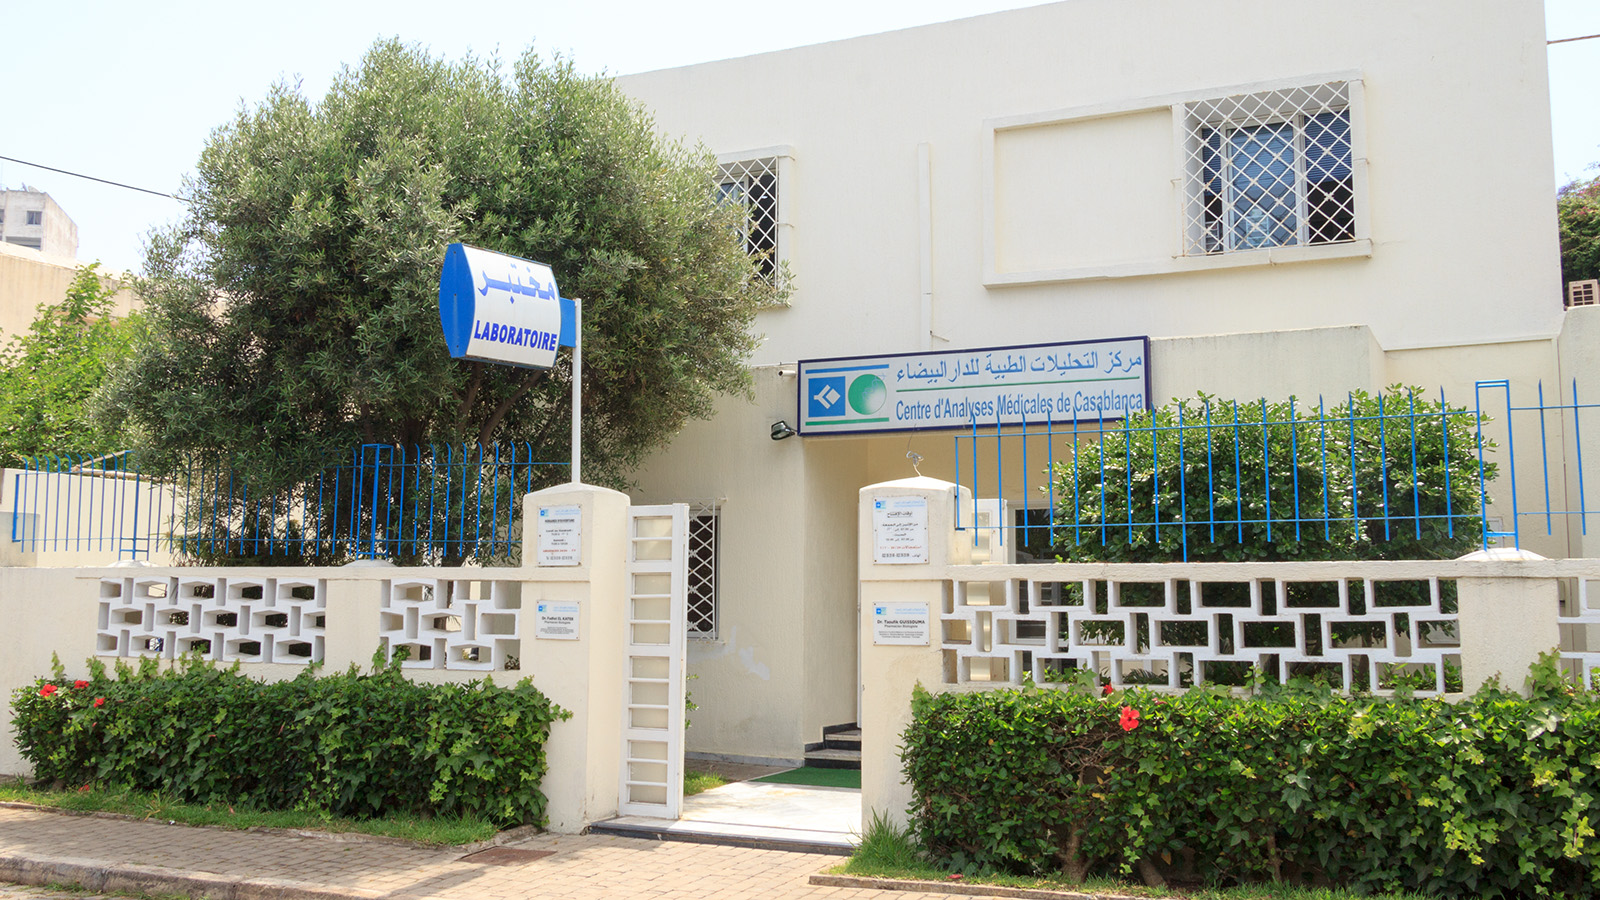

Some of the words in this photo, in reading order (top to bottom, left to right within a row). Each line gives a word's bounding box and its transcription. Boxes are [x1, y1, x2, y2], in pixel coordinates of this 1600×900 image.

[477, 263, 556, 304] مختبر
[474, 320, 558, 351] LABORATOIRE
[896, 360, 947, 384] البيضاء
[985, 353, 1027, 380] الطبية
[1030, 351, 1098, 376] التحليلات
[1104, 350, 1142, 374] مركز
[896, 400, 931, 420] Centre
[934, 396, 994, 423] d'Analyses
[997, 393, 1053, 415] Médicales
[1056, 391, 1071, 413] de
[1074, 389, 1142, 413] Casablanca
